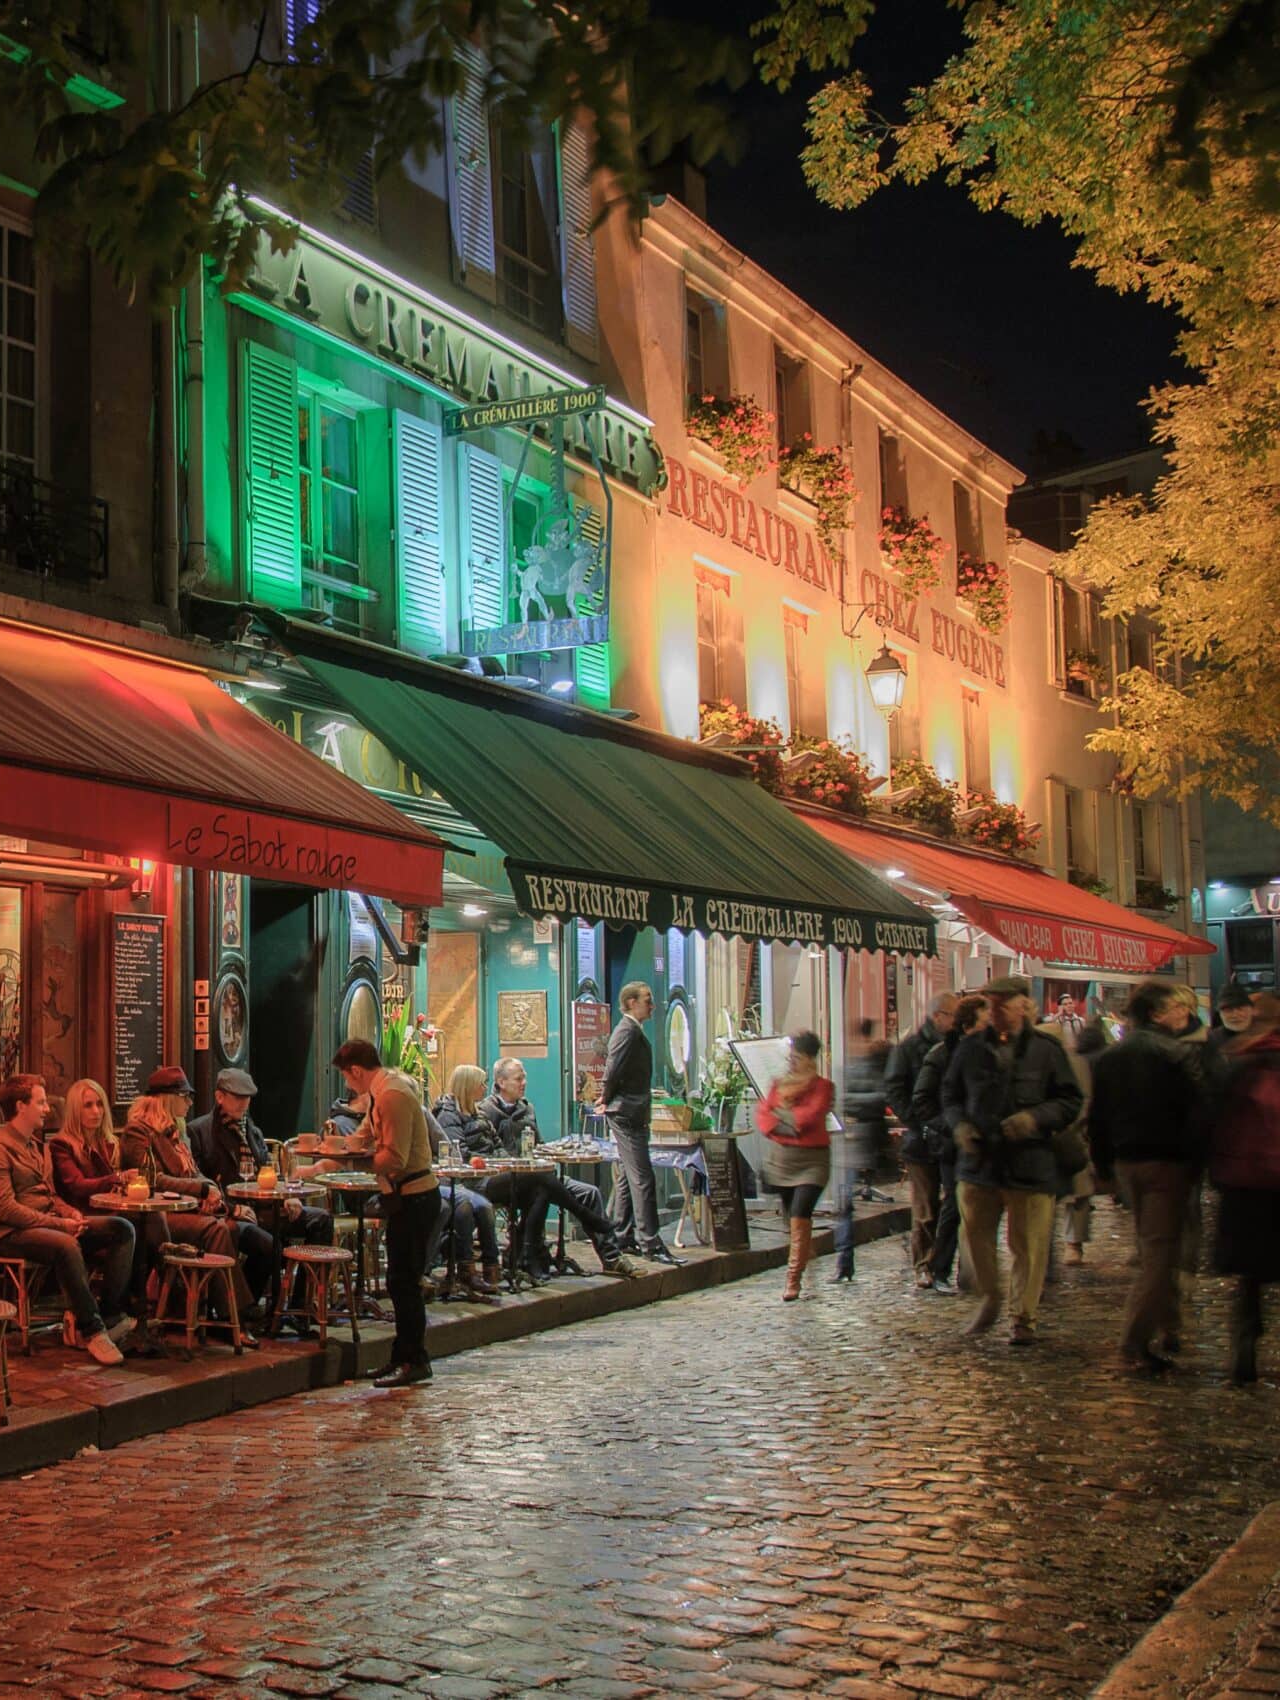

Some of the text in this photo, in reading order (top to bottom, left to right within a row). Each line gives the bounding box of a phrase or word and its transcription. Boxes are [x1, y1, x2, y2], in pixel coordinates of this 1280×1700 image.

[666, 456, 849, 600] RESTAURANT
[860, 568, 920, 643] CHEZ
[166, 802, 358, 889] Le Sabot rouge
[525, 874, 650, 923] RESTAURANT
[671, 894, 697, 928] LA
[831, 916, 863, 945] 1900
[874, 921, 929, 951] CABARET
[1061, 926, 1099, 961] CHEZ
